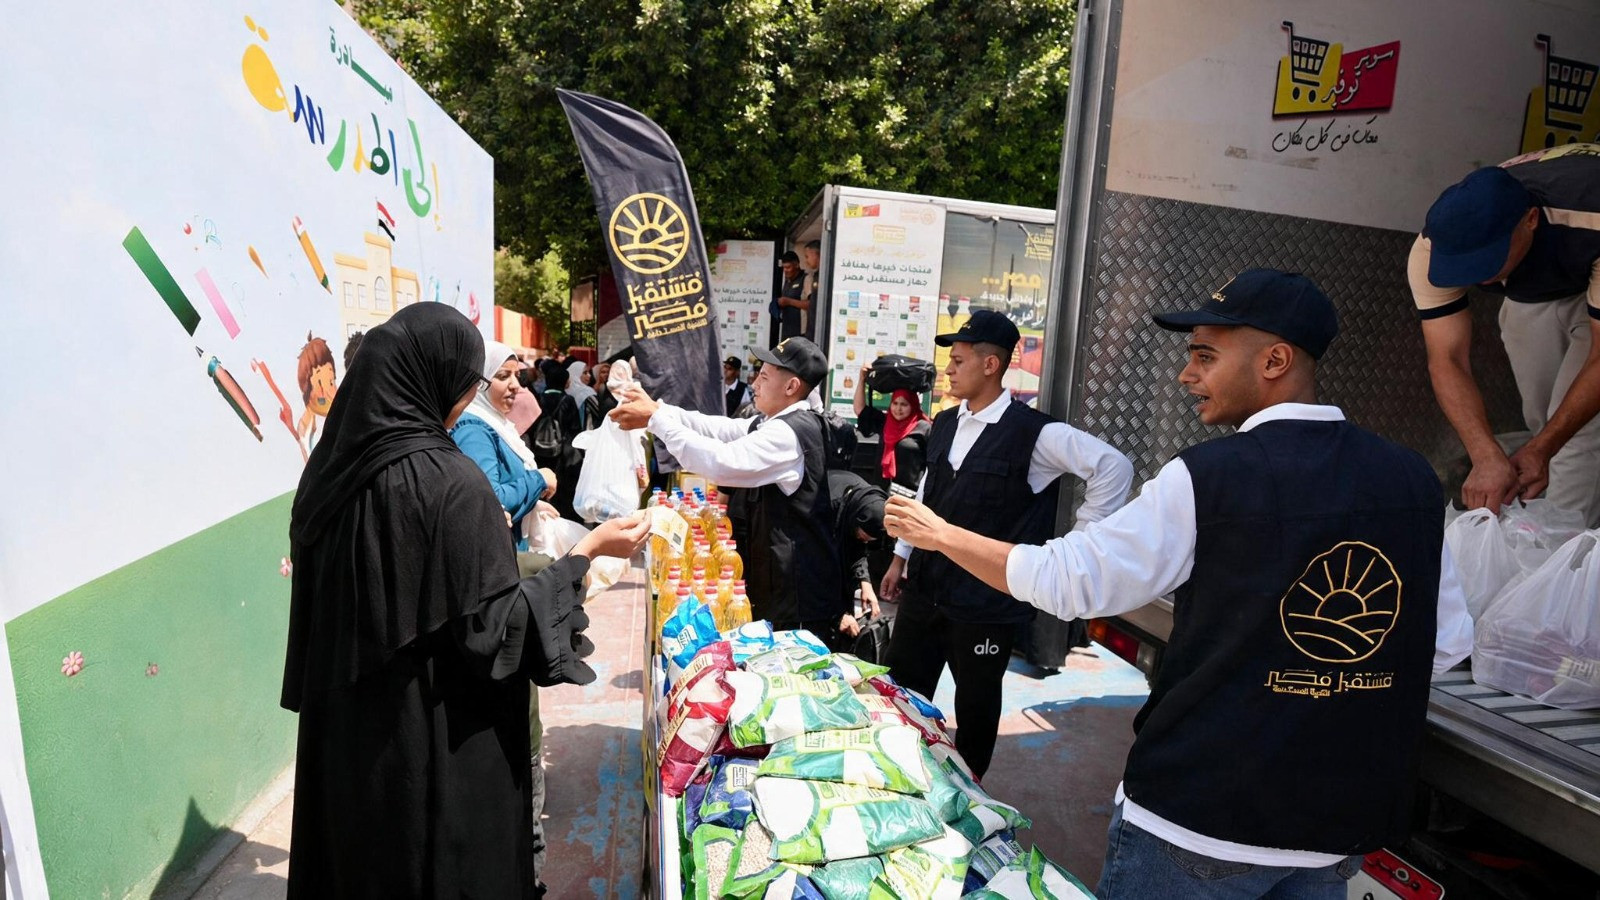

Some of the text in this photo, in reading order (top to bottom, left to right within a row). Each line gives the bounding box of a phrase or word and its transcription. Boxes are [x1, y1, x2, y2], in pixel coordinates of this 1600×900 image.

[328, 25, 393, 105] مبادرة
[1354, 49, 1394, 71] سوبر
[1320, 69, 1361, 108] توفير
[241, 15, 442, 231] إلى المدرسة
[1271, 118, 1308, 152] مكان
[1305, 118, 1336, 151] كل
[842, 273, 928, 287] جهاز مستقبل مصر
[872, 261, 897, 273] خيرها
[899, 263, 932, 276] منتجات
[626, 270, 704, 315] مستقبل
[633, 296, 709, 340] مصر
[974, 638, 1000, 655] alo
[1263, 668, 1333, 687] مصر
